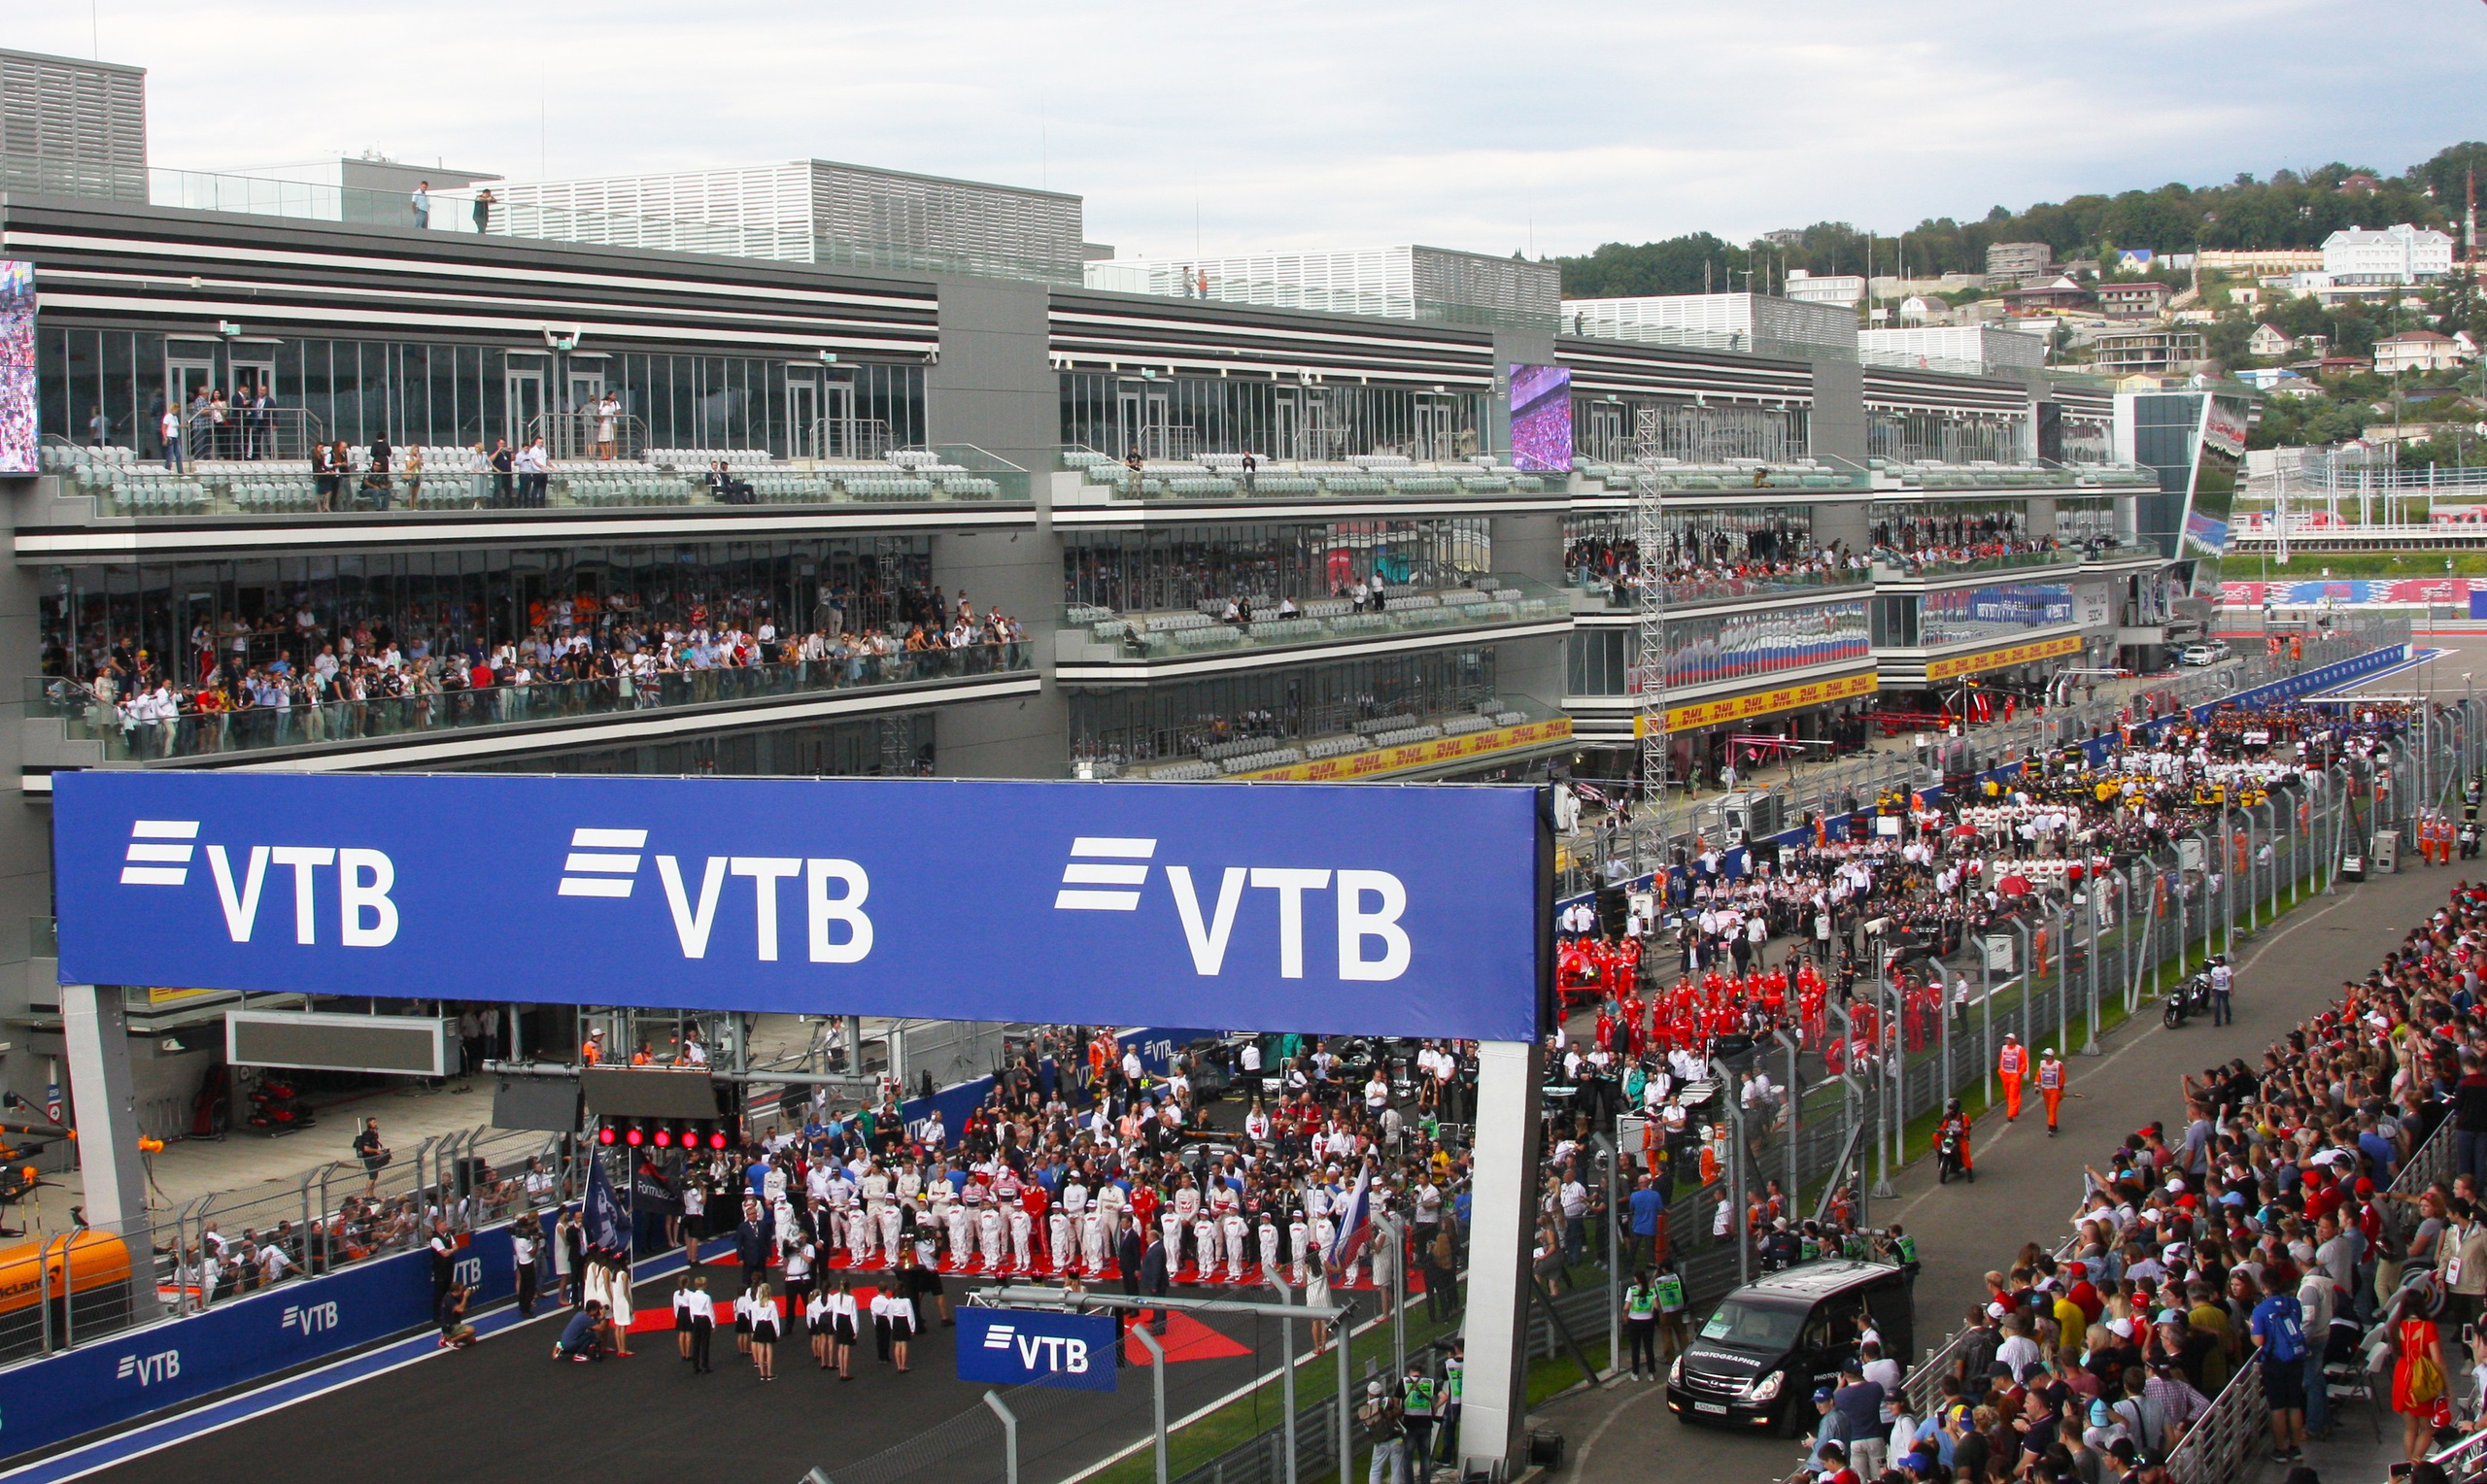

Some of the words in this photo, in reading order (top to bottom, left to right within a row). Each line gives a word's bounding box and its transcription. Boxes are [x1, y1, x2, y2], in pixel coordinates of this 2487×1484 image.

[1772, 691, 1792, 707] DHL
[1799, 687, 1819, 702] DHL
[1714, 702, 1735, 720] DHL
[1744, 696, 1765, 714] DHL
[1682, 707, 1704, 725] DHL
[1511, 727, 1537, 744] DHL
[1545, 721, 1568, 738] DHL
[1436, 740, 1464, 759] DHL
[1474, 733, 1501, 752] DHL
[1353, 754, 1382, 774] DHL
[1394, 746, 1424, 765] DHL
[1308, 762, 1340, 781] DHL
[206, 845, 399, 948] VTB
[655, 855, 874, 964] VTB
[1165, 865, 1413, 982] VTB
[299, 1300, 339, 1335] VTB
[1017, 1334, 1089, 1373] VTB
[1690, 1350, 1761, 1368] PHOTOGRAPHER
[136, 1349, 181, 1387] VTB
